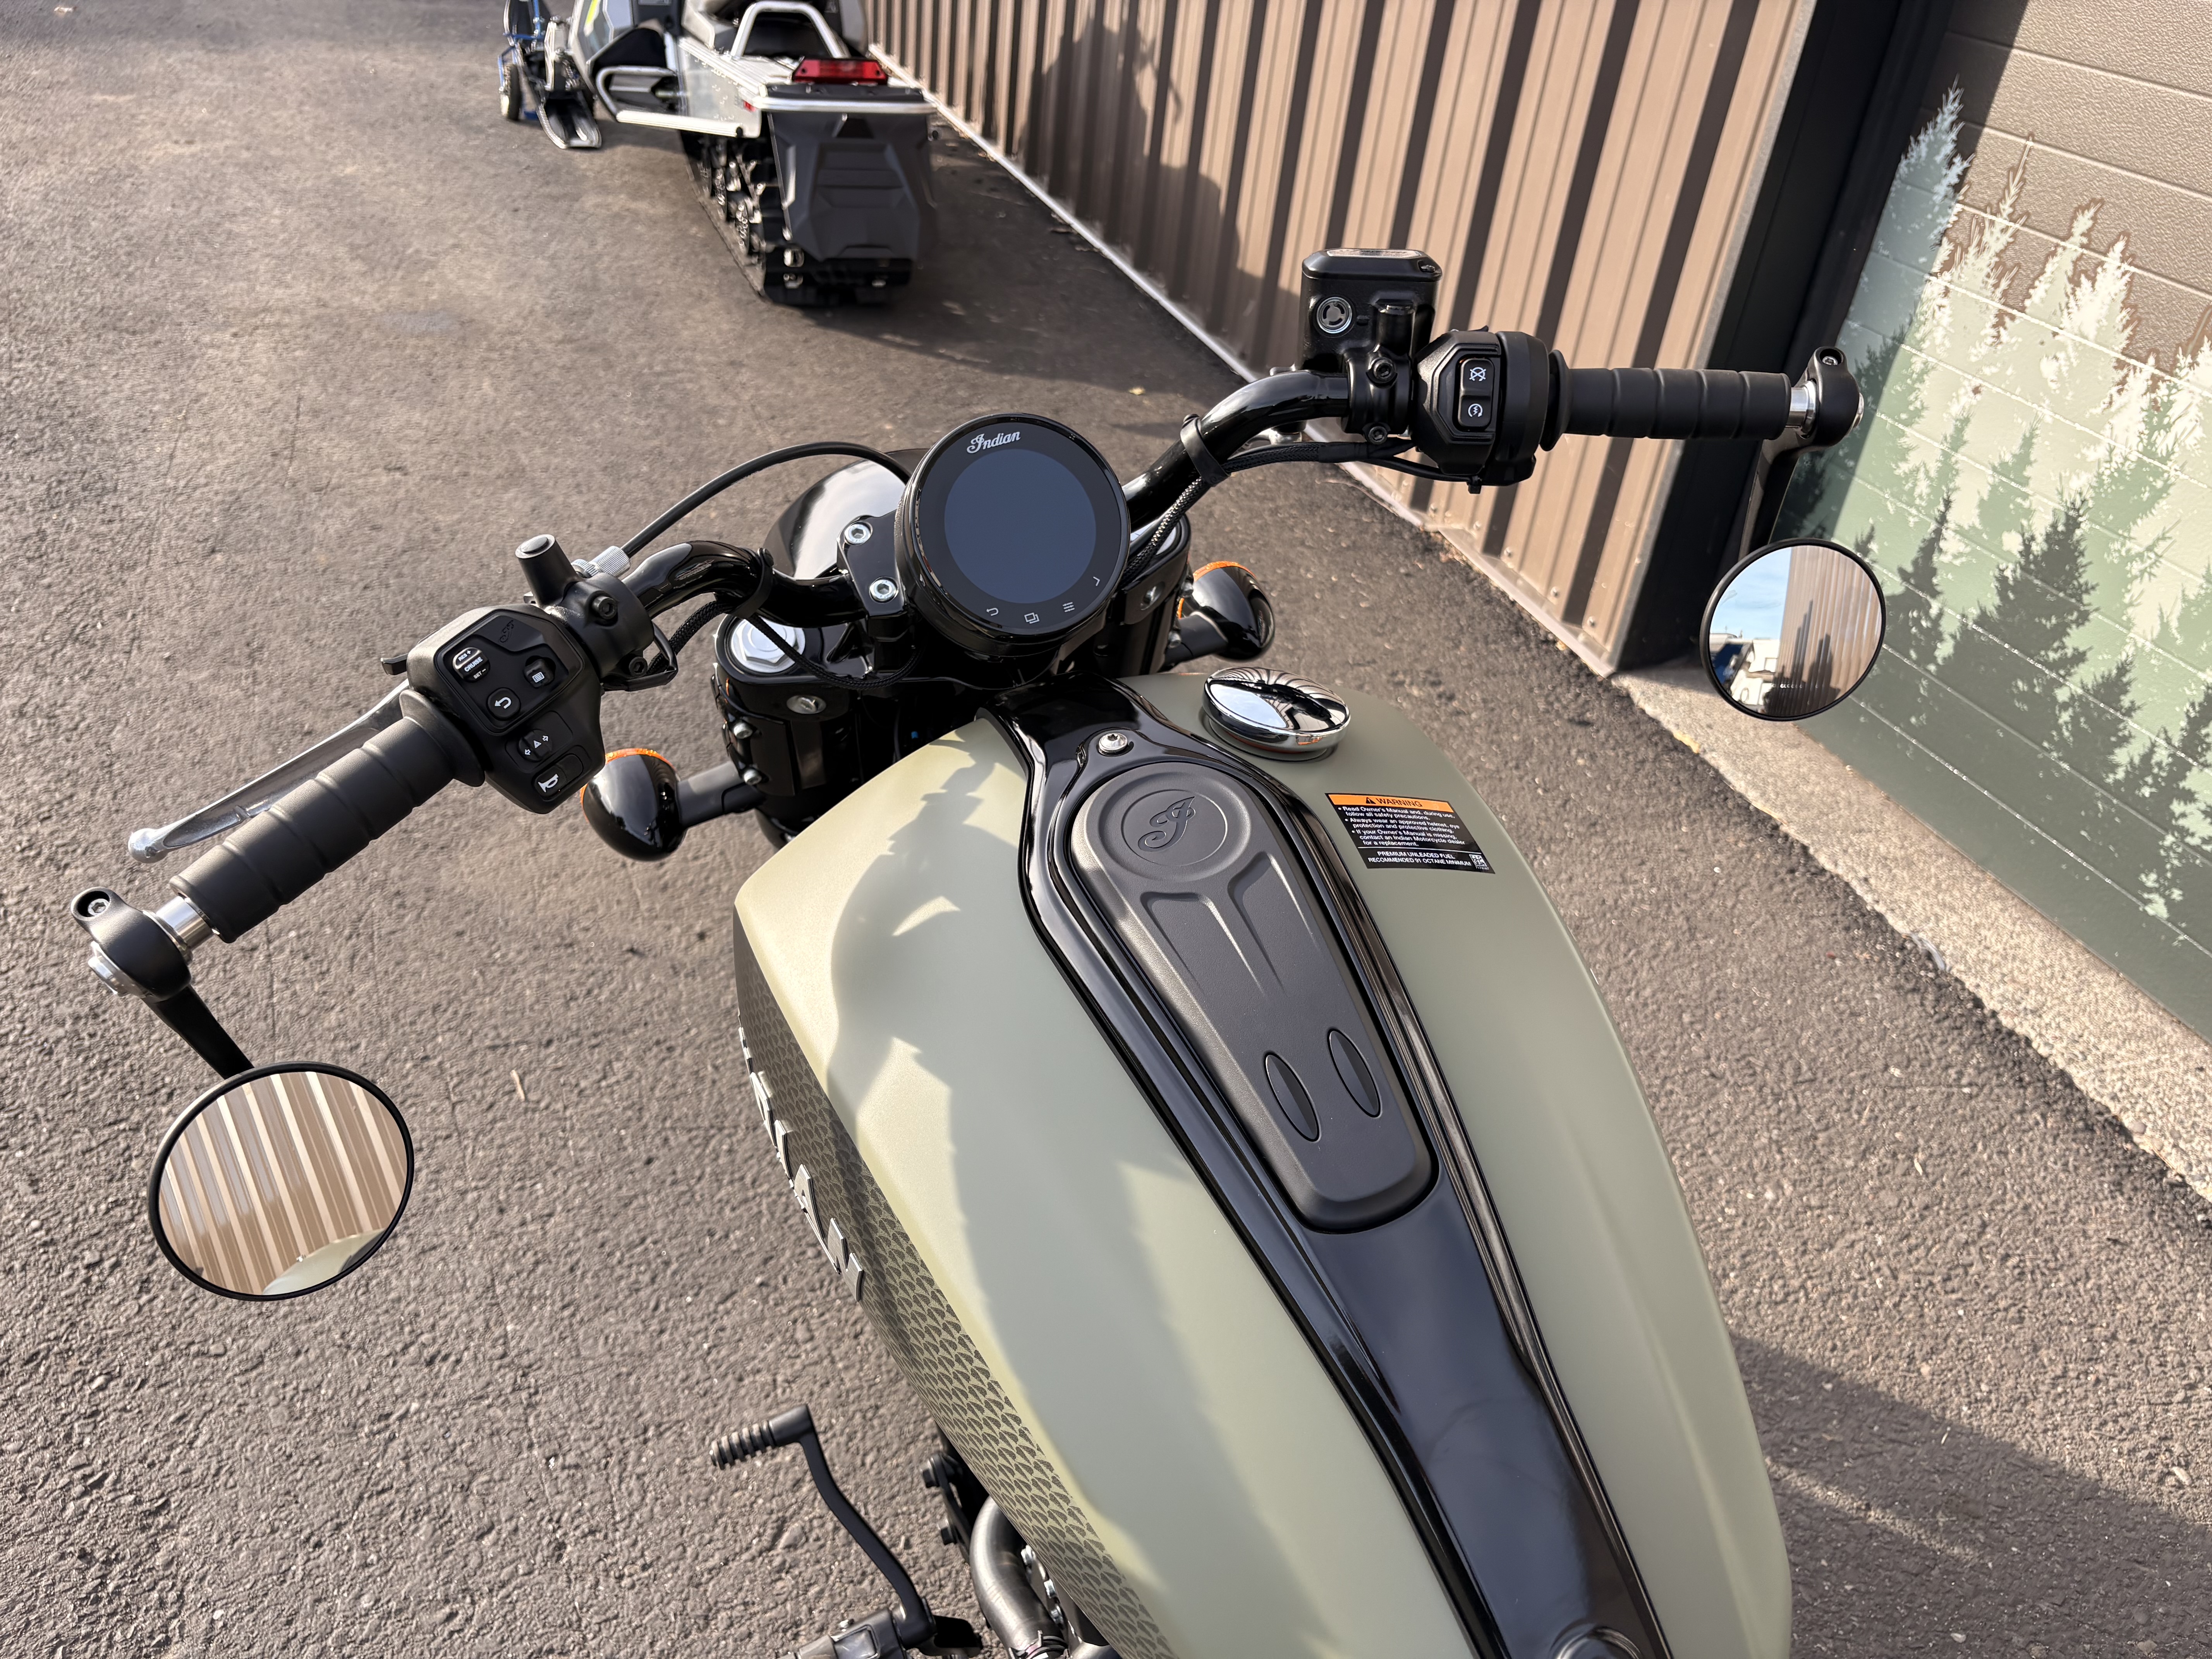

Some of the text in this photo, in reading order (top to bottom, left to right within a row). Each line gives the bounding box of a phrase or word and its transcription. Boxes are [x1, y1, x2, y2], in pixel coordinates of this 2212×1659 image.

[967, 431, 1021, 453] Indian
[464, 656, 483, 672] CRUISE
[473, 671, 482, 679] SET
[1376, 798, 1423, 807] WARNING
